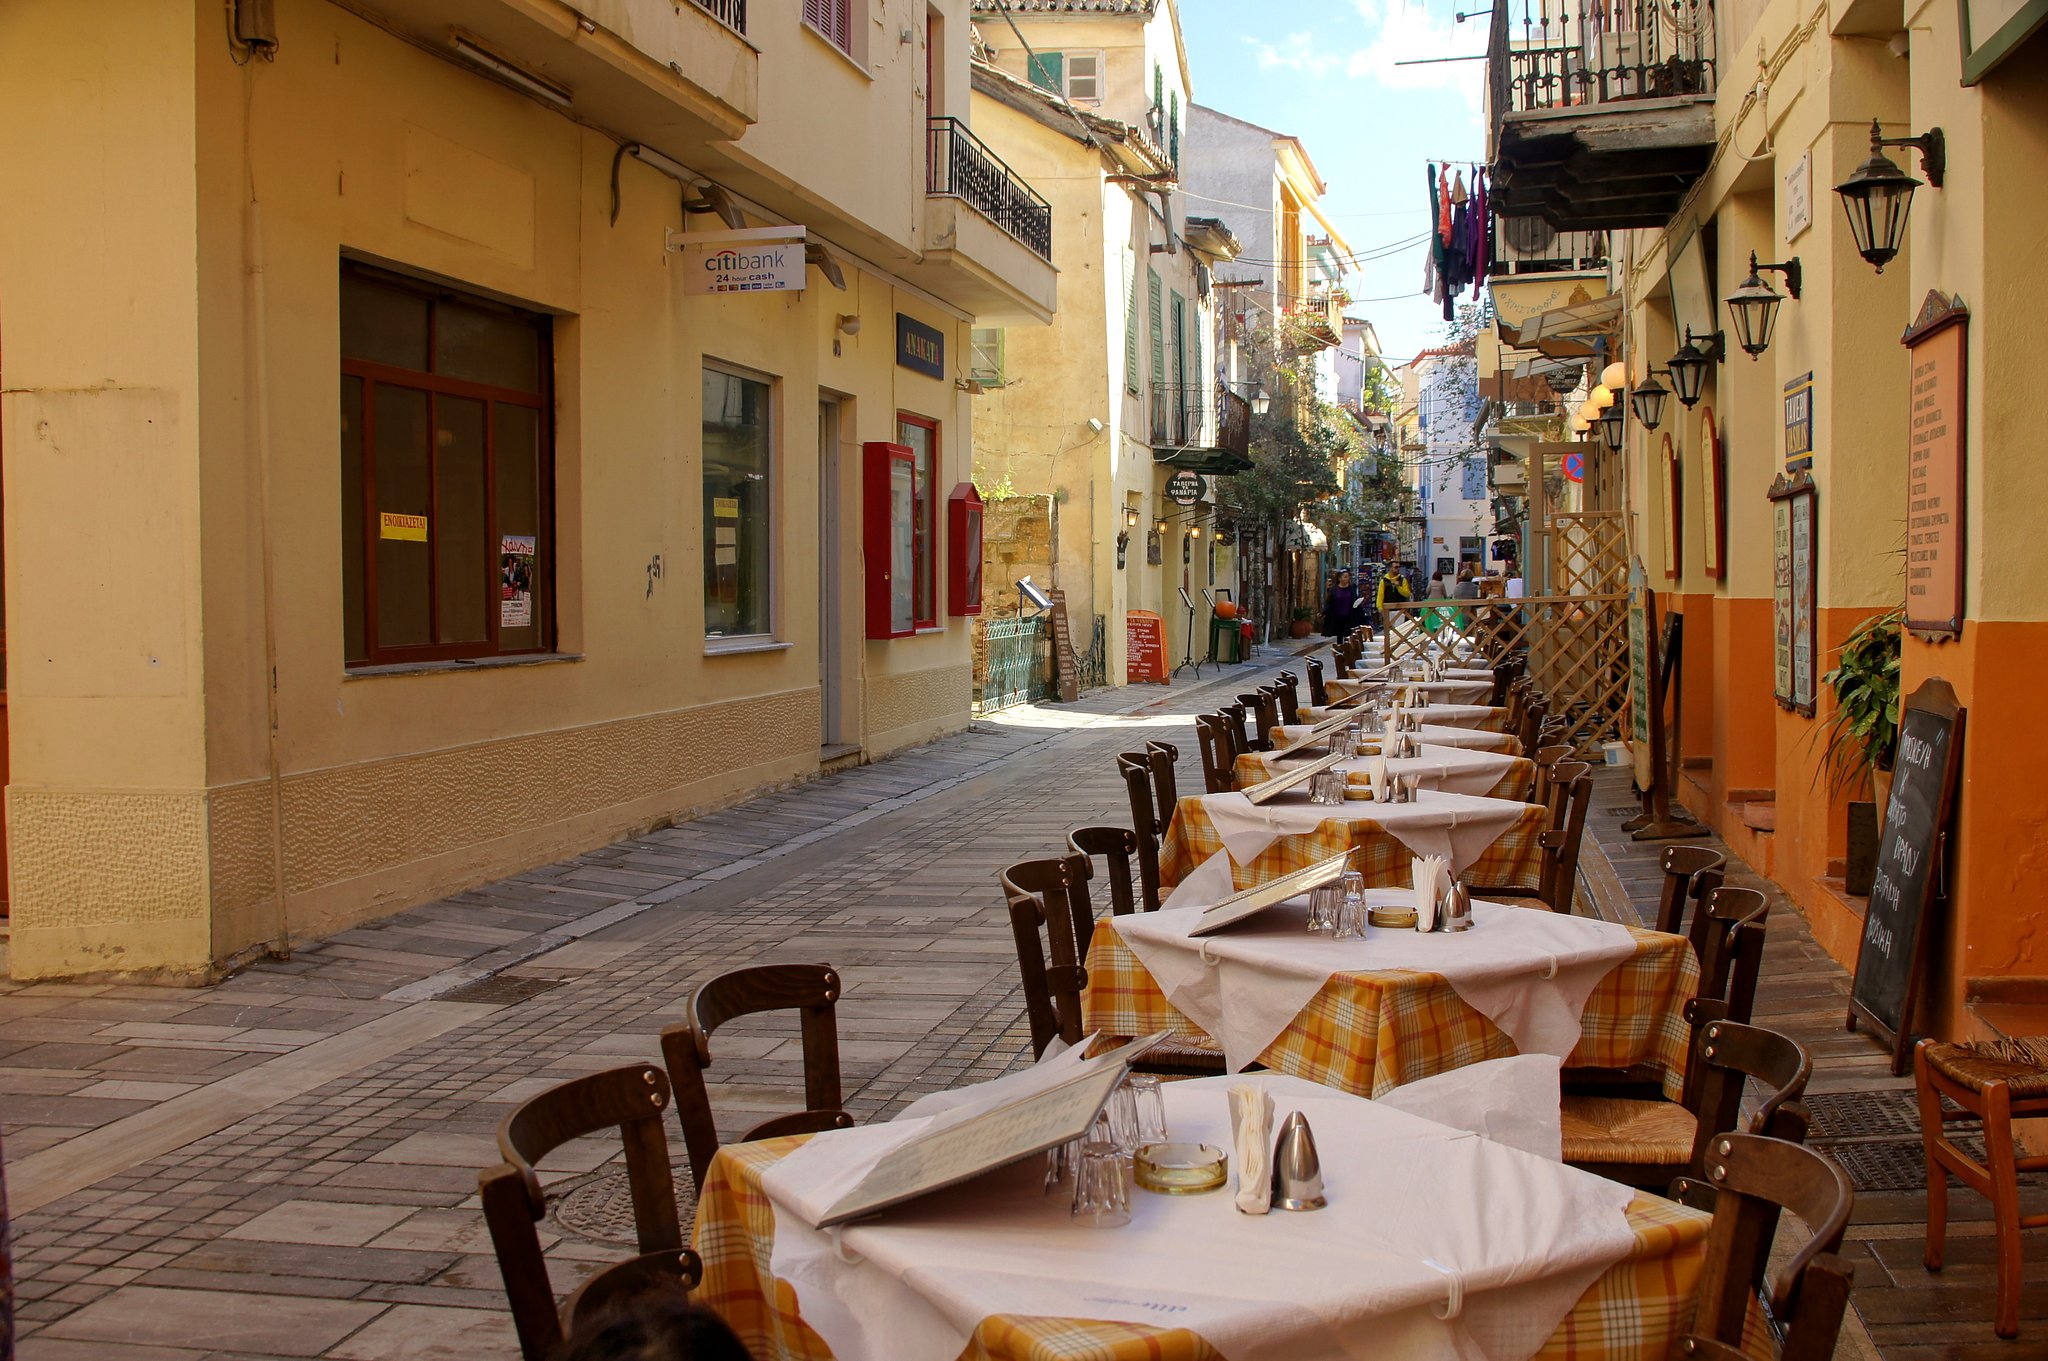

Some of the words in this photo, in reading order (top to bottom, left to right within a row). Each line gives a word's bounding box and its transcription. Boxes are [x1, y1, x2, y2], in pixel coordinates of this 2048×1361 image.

[705, 250, 784, 271] citibank
[716, 274, 730, 283] 24
[749, 272, 775, 281] cash
[384, 514, 425, 529] ΕΝΟΙΚΙΑΖΕΤΑΙ
[1893, 834, 1920, 878] ΒΡΑΔΥ
